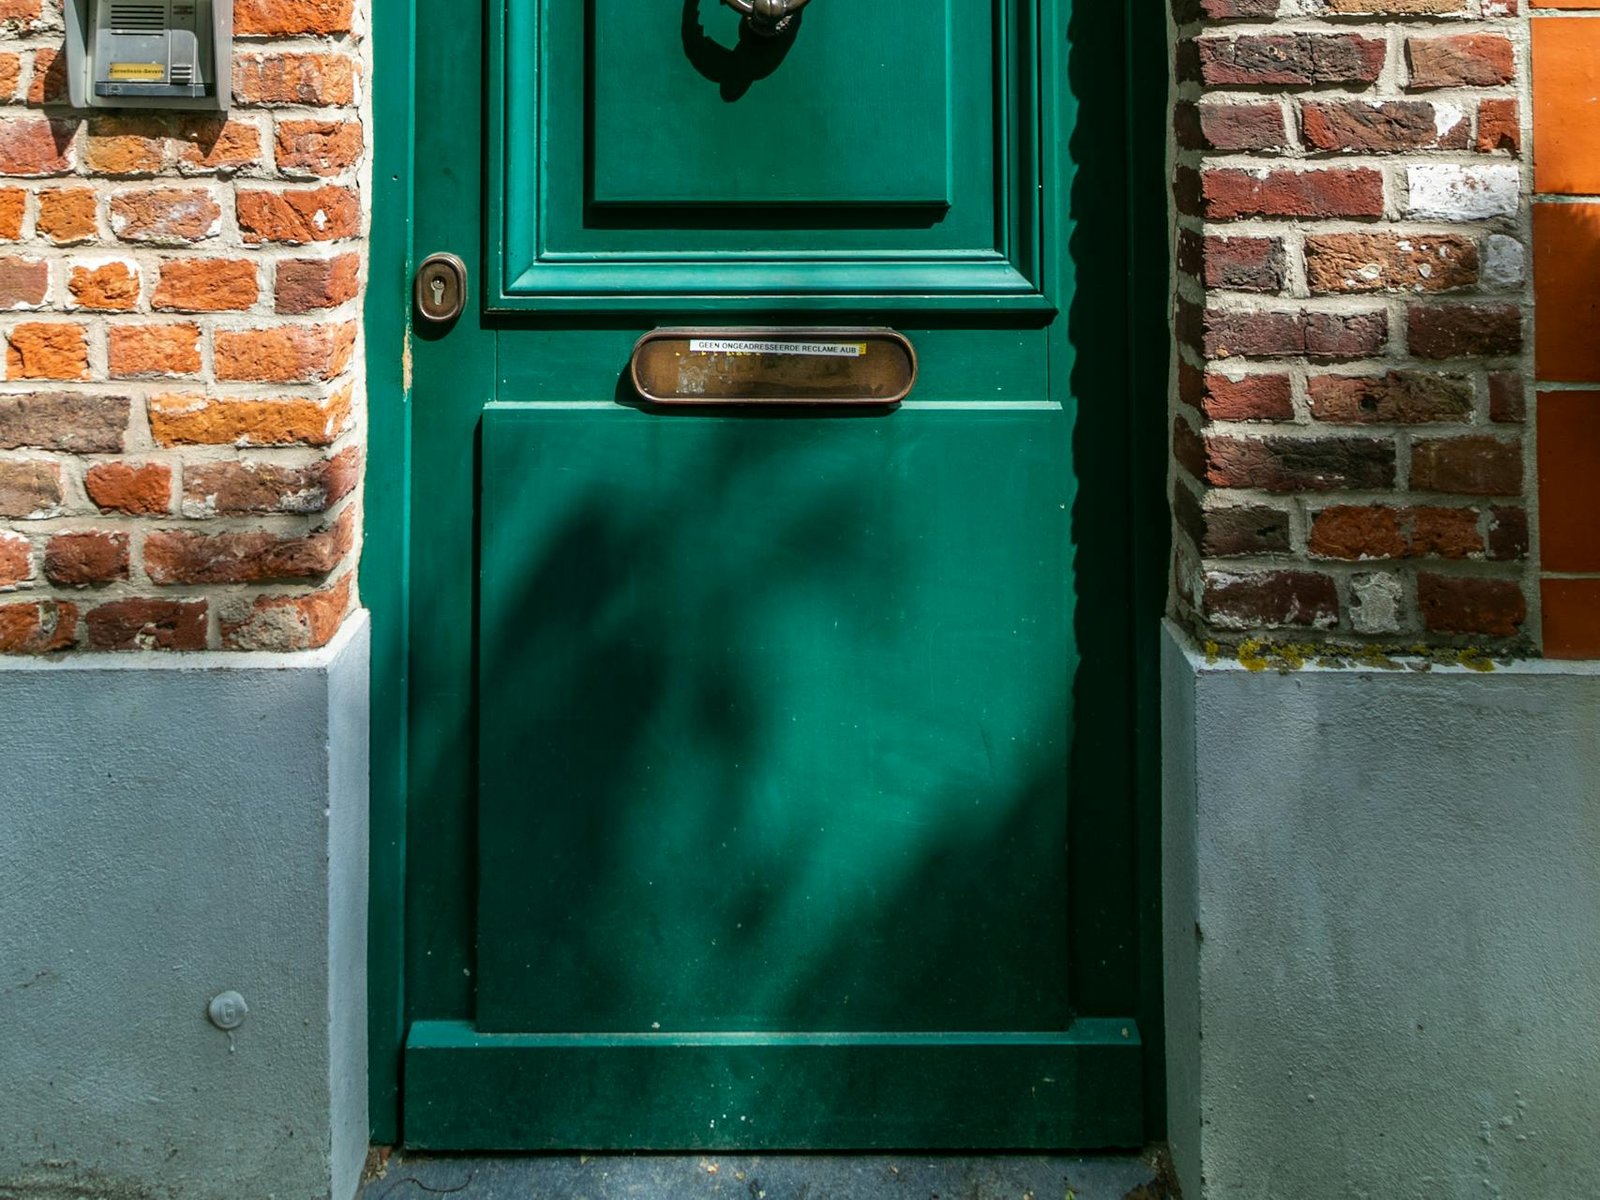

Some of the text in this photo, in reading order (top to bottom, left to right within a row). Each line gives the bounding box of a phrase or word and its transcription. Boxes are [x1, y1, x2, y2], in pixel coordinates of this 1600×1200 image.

[698, 341, 857, 354] GEEN ONGEADRESSEERDE RECLAME AUB
